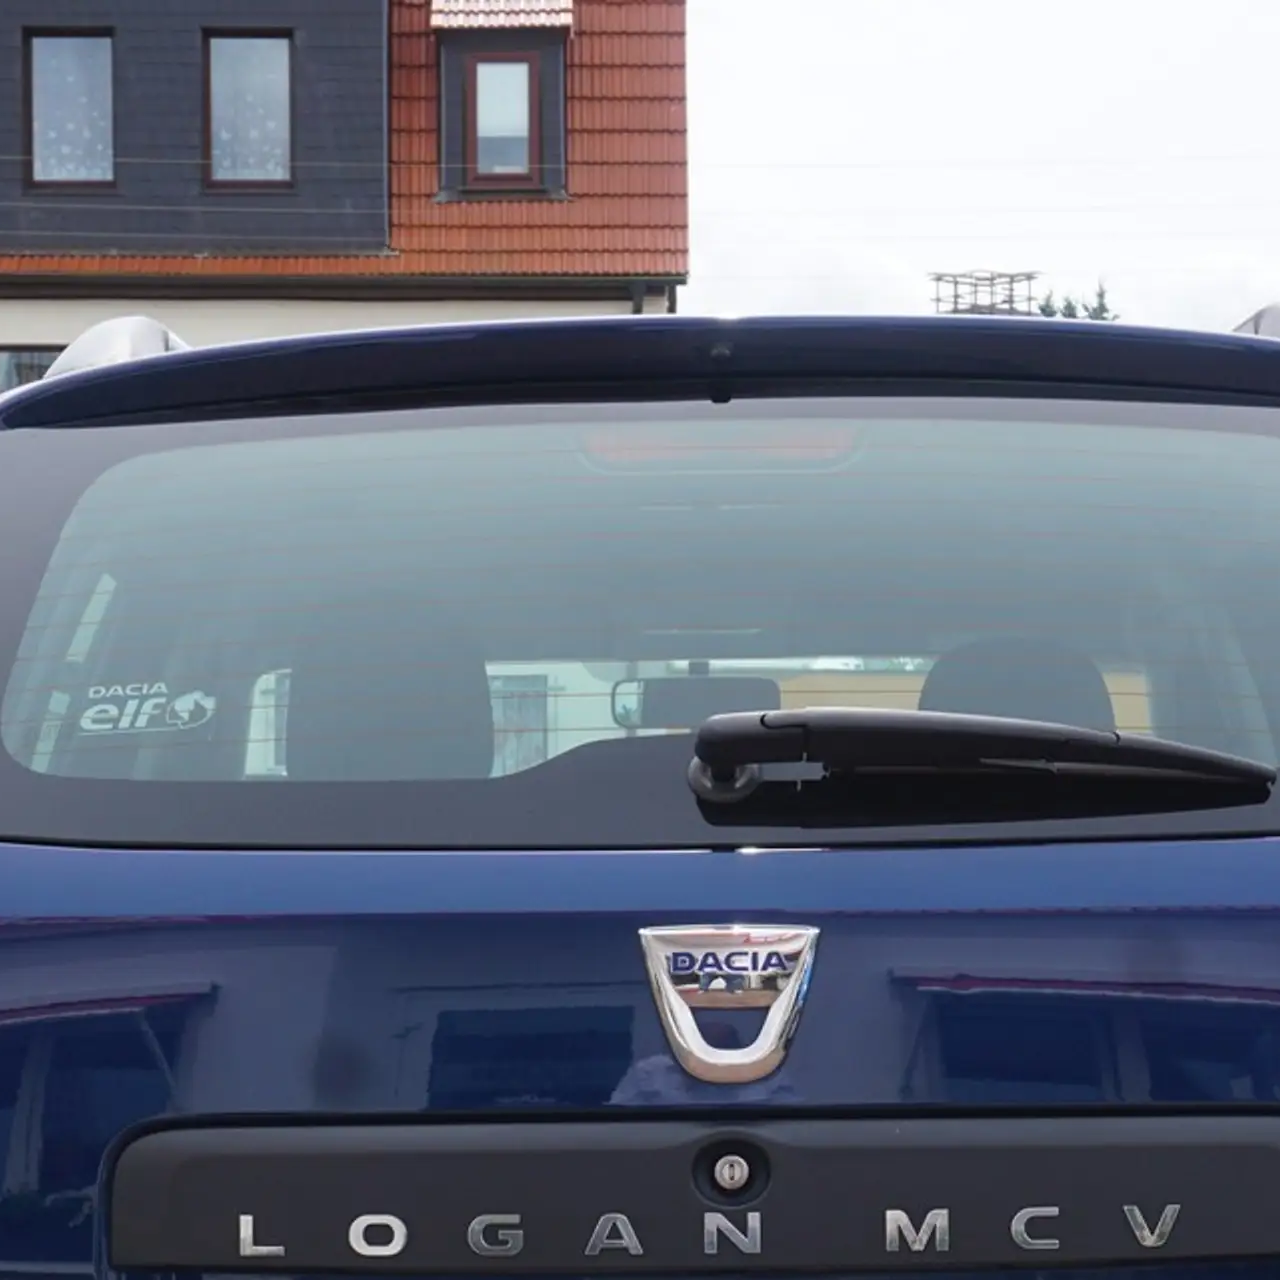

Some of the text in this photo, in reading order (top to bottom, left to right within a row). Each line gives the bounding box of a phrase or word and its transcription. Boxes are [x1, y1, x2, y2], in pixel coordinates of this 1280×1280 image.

[87, 682, 169, 699] DACIA
[79, 697, 168, 731] elf
[671, 951, 788, 972] DACIA
[238, 1203, 1182, 1257] LOGAN MCV
